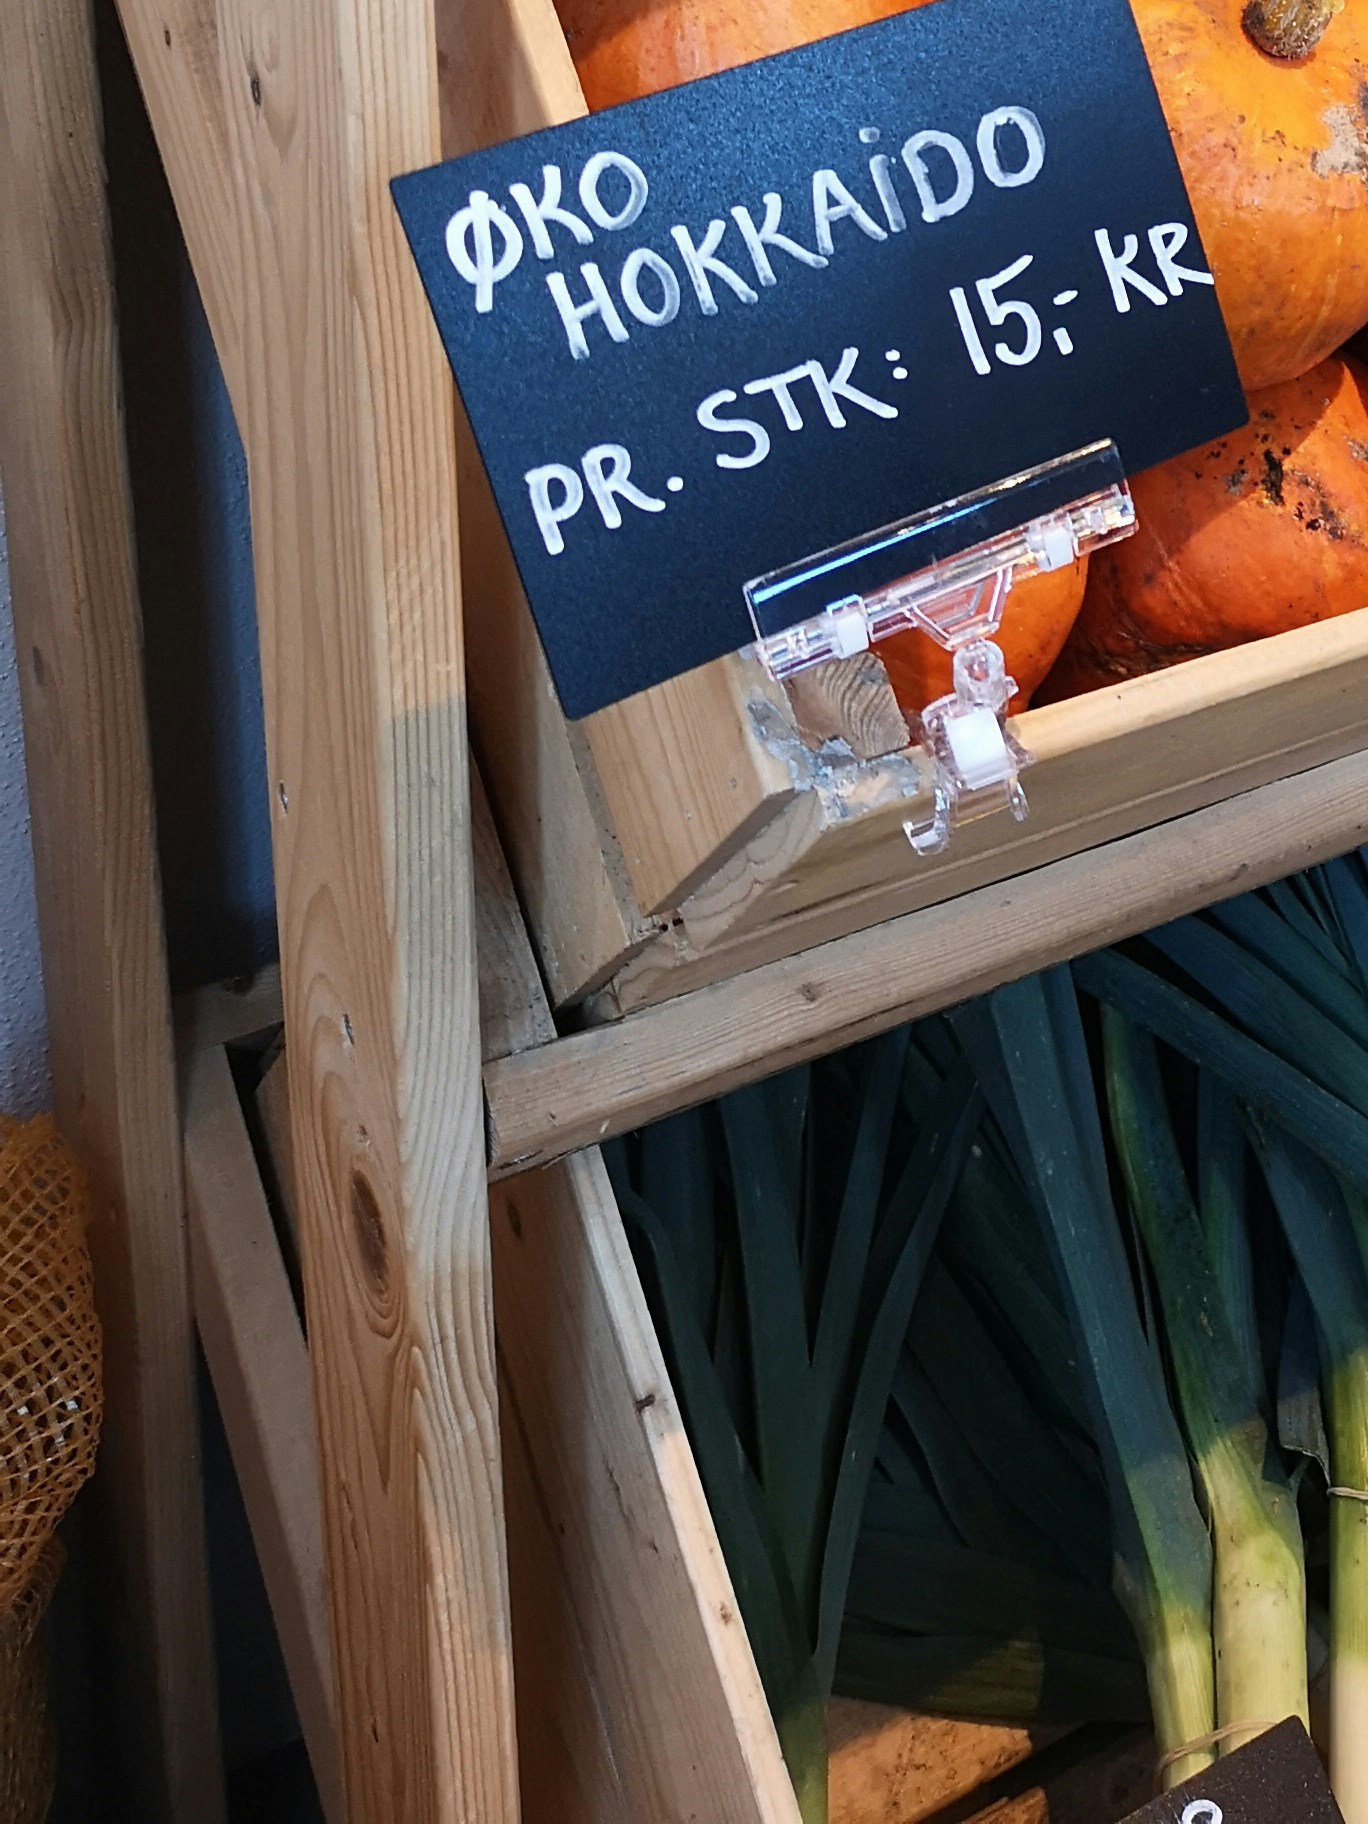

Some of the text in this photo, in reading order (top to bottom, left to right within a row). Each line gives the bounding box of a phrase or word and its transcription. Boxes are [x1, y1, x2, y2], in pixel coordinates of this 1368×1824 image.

[446, 151, 648, 313] ØKO
[525, 444, 684, 555] PR.
[697, 347, 909, 468] STK:
[1095, 222, 1214, 314] KR
